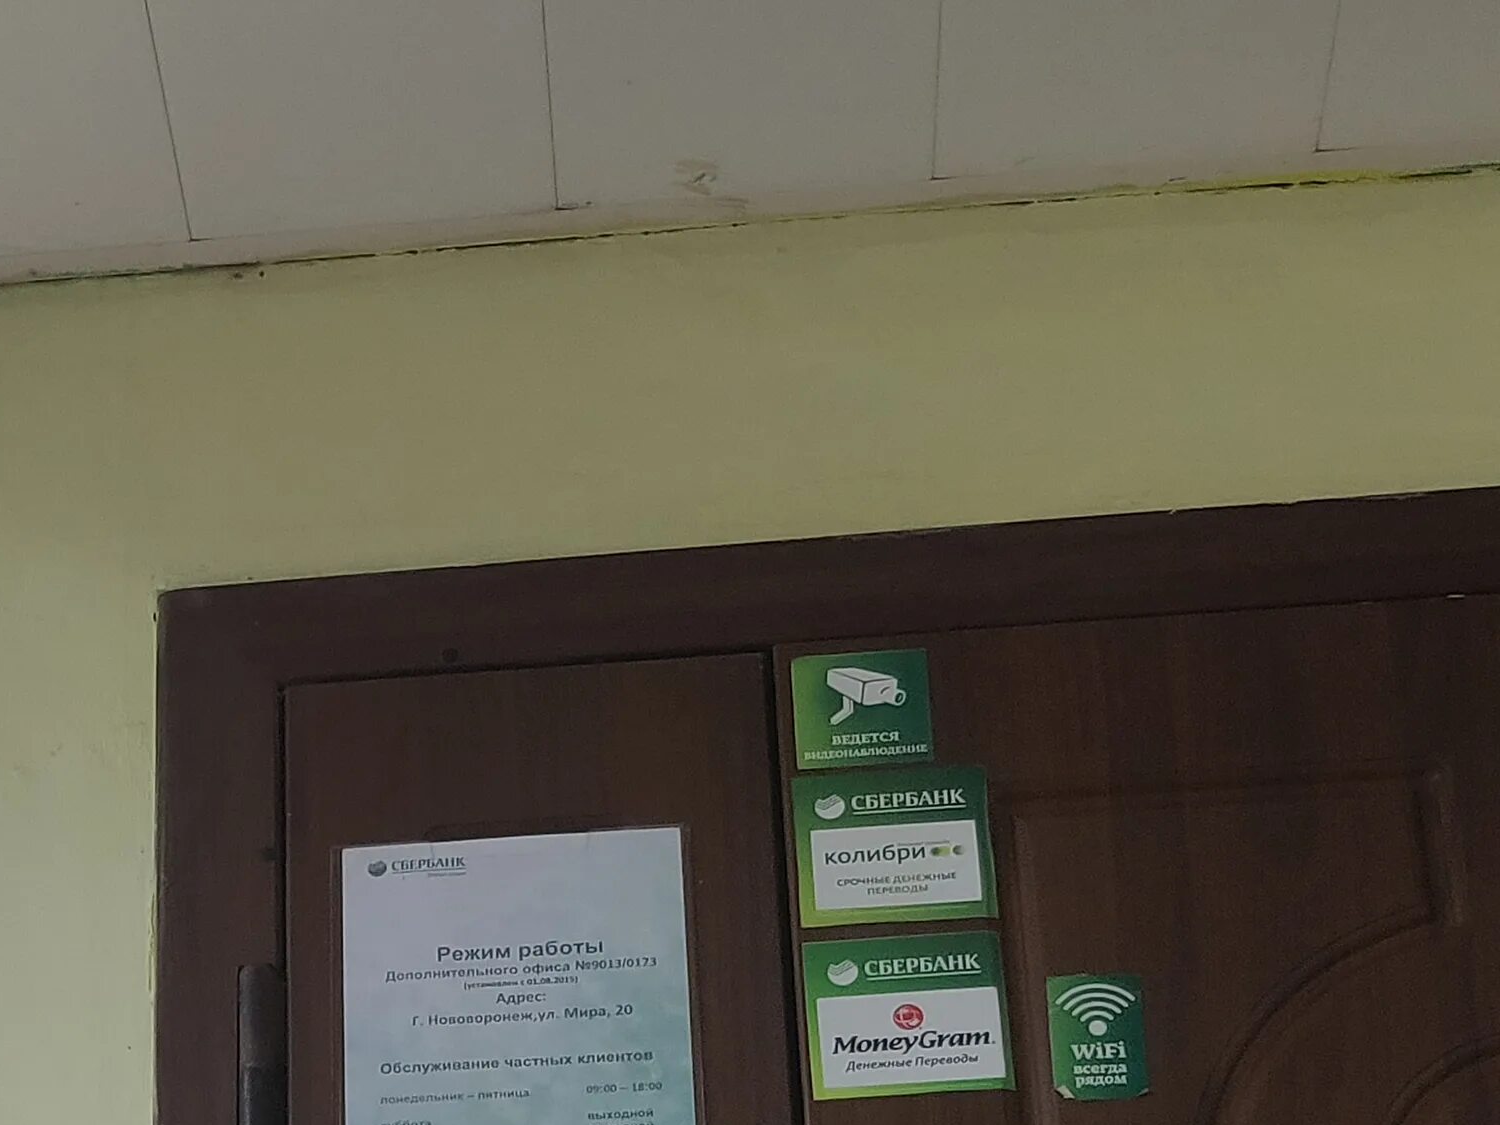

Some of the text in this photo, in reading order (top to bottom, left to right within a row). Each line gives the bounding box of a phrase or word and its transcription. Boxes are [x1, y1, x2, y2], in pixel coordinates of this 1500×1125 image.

[831, 731, 901, 746] ВЕДЕТСЯ
[803, 744, 928, 760] ВИДЕОНАБЛЮДЕНИЕ
[850, 788, 967, 811] СБЕРБАНК
[391, 856, 467, 871] СБЕРБАНК
[824, 843, 926, 865] колибри
[836, 871, 957, 887] СРОЧНЫЕ ДЕНЕЖНЫЕ
[867, 884, 929, 896] ПЕРЕВОДЫ
[436, 940, 604, 962] Режим работы
[385, 964, 518, 983] Дополнительного
[522, 961, 571, 977] офиса
[863, 953, 982, 977] СБЕРБАНК
[495, 991, 547, 1007] Адрес:
[564, 1006, 611, 1021] Мира,
[615, 1003, 634, 1017] 20
[832, 1030, 991, 1055] MoneyGram
[1070, 1040, 1127, 1060] WiFi
[379, 1050, 655, 1077] Обслуживание частных клиентов
[845, 1053, 979, 1073] Денежные Переводы
[1073, 1063, 1128, 1075] всегда
[1075, 1074, 1128, 1089] рядом
[380, 1091, 465, 1105] понедельник
[477, 1087, 531, 1102] пятница
[632, 1080, 664, 1093] 18:00
[587, 1107, 655, 1121] выходной
